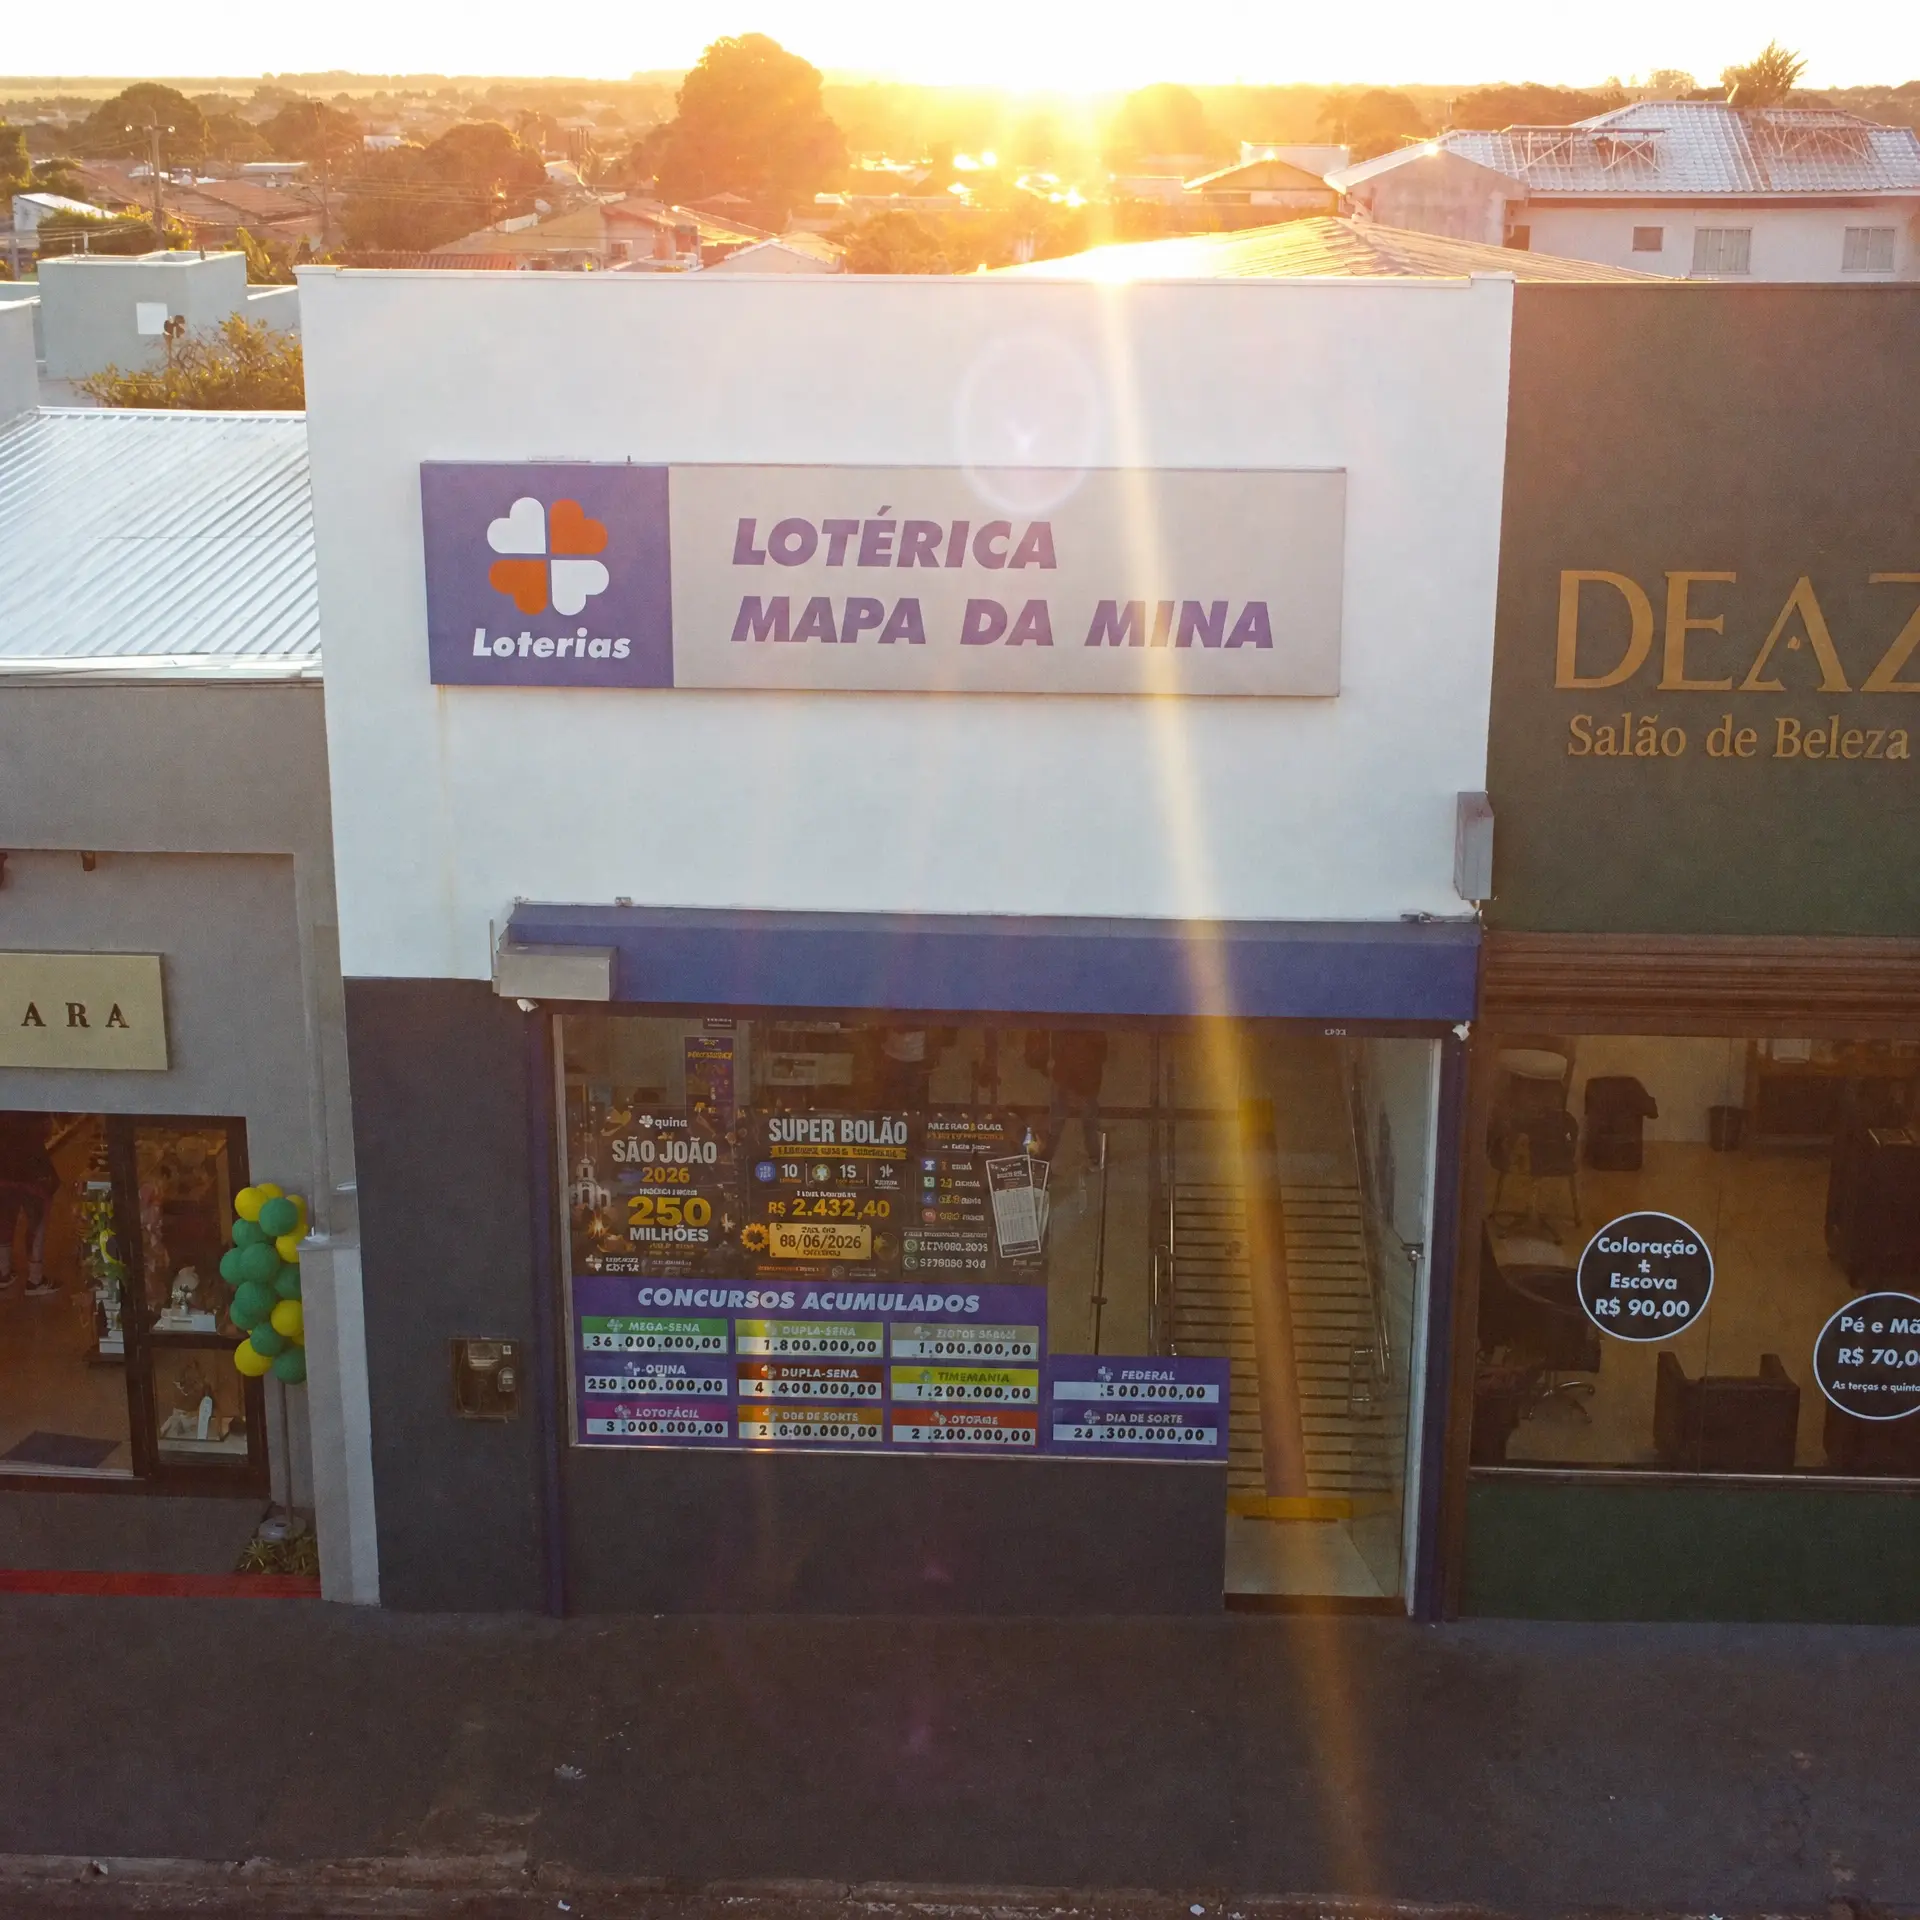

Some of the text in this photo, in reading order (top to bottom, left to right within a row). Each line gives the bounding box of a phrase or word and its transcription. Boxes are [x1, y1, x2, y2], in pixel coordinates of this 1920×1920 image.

[732, 505, 1057, 569] LOTÉRICA
[730, 596, 1273, 648] MAPA DA MINA
[472, 627, 631, 659] Loterias
[1568, 712, 1911, 759] Salão de Beleza
[654, 1116, 688, 1129] quina
[768, 1116, 908, 1144] SUPER BOLÃO
[612, 1136, 718, 1163] SÃO JOÃO
[641, 1166, 691, 1183] 2026
[781, 1163, 798, 1178] 10
[627, 1196, 712, 1227] 250
[768, 1199, 891, 1220] R$ 2.432,40
[629, 1225, 709, 1242] MILHÕES
[1597, 1237, 1698, 1258] Coloração
[1610, 1273, 1678, 1290] Escova
[637, 1287, 980, 1313] CONCURSOS ACUMULADOS
[1595, 1297, 1690, 1320] R$ 90,00
[628, 1321, 700, 1332] MEGA-SENA
[1840, 1316, 1865, 1333] Pé
[1871, 1321, 1884, 1333] e
[1838, 1346, 1920, 1369] R$ 70,0
[781, 1367, 859, 1379] DUPLA-SENA
[937, 1371, 1010, 1383] TIMEMANIA
[1121, 1370, 1176, 1381] FEDERAL
[1832, 1380, 1846, 1390] As
[1848, 1381, 1879, 1393] terças
[635, 1406, 700, 1418] LOTOFÁCIL
[1106, 1413, 1184, 1424] DIA DE SORTE
